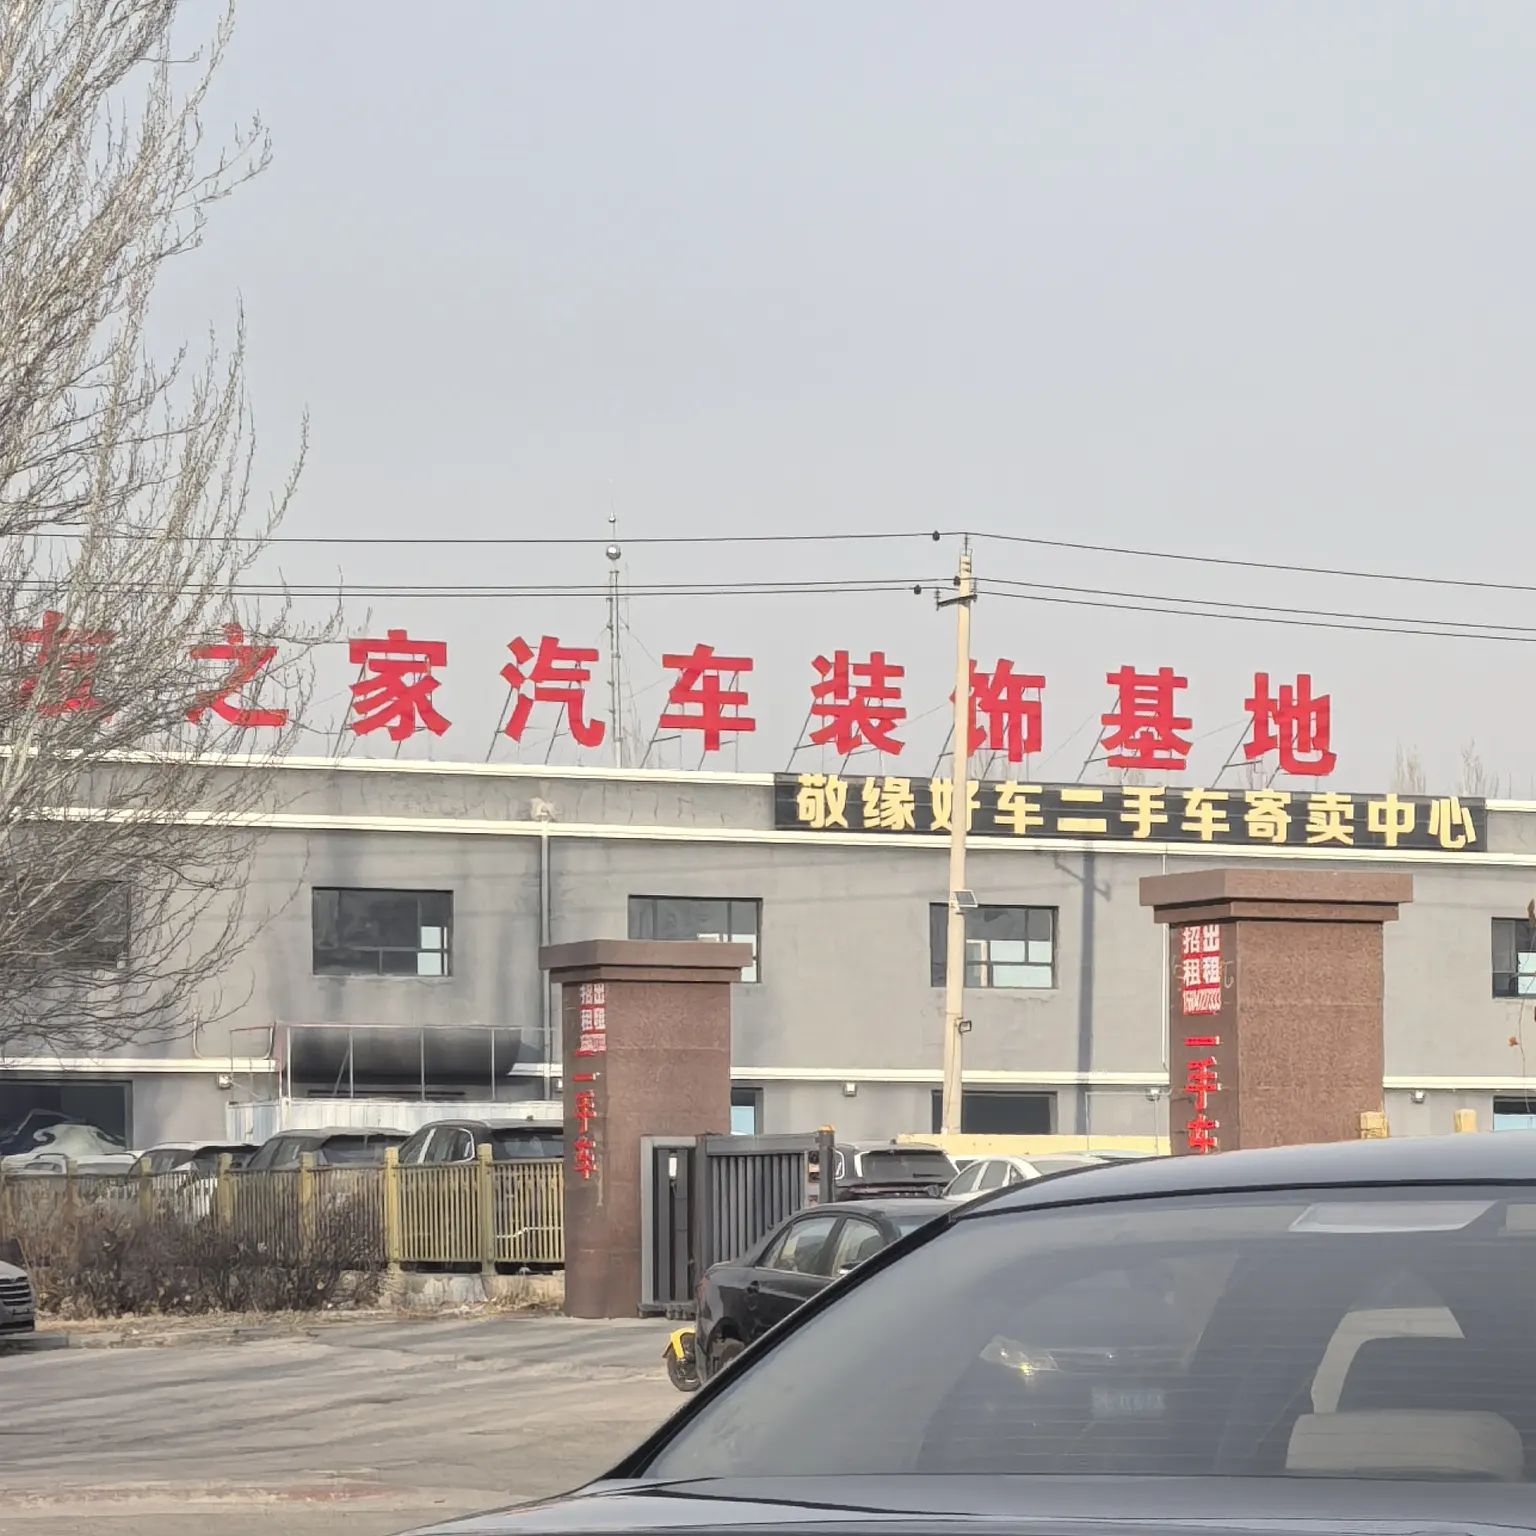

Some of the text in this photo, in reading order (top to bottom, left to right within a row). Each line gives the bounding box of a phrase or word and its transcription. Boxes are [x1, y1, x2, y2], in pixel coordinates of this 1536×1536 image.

[796, 773, 1477, 849] 敬缘好车二手车寄卖中心
